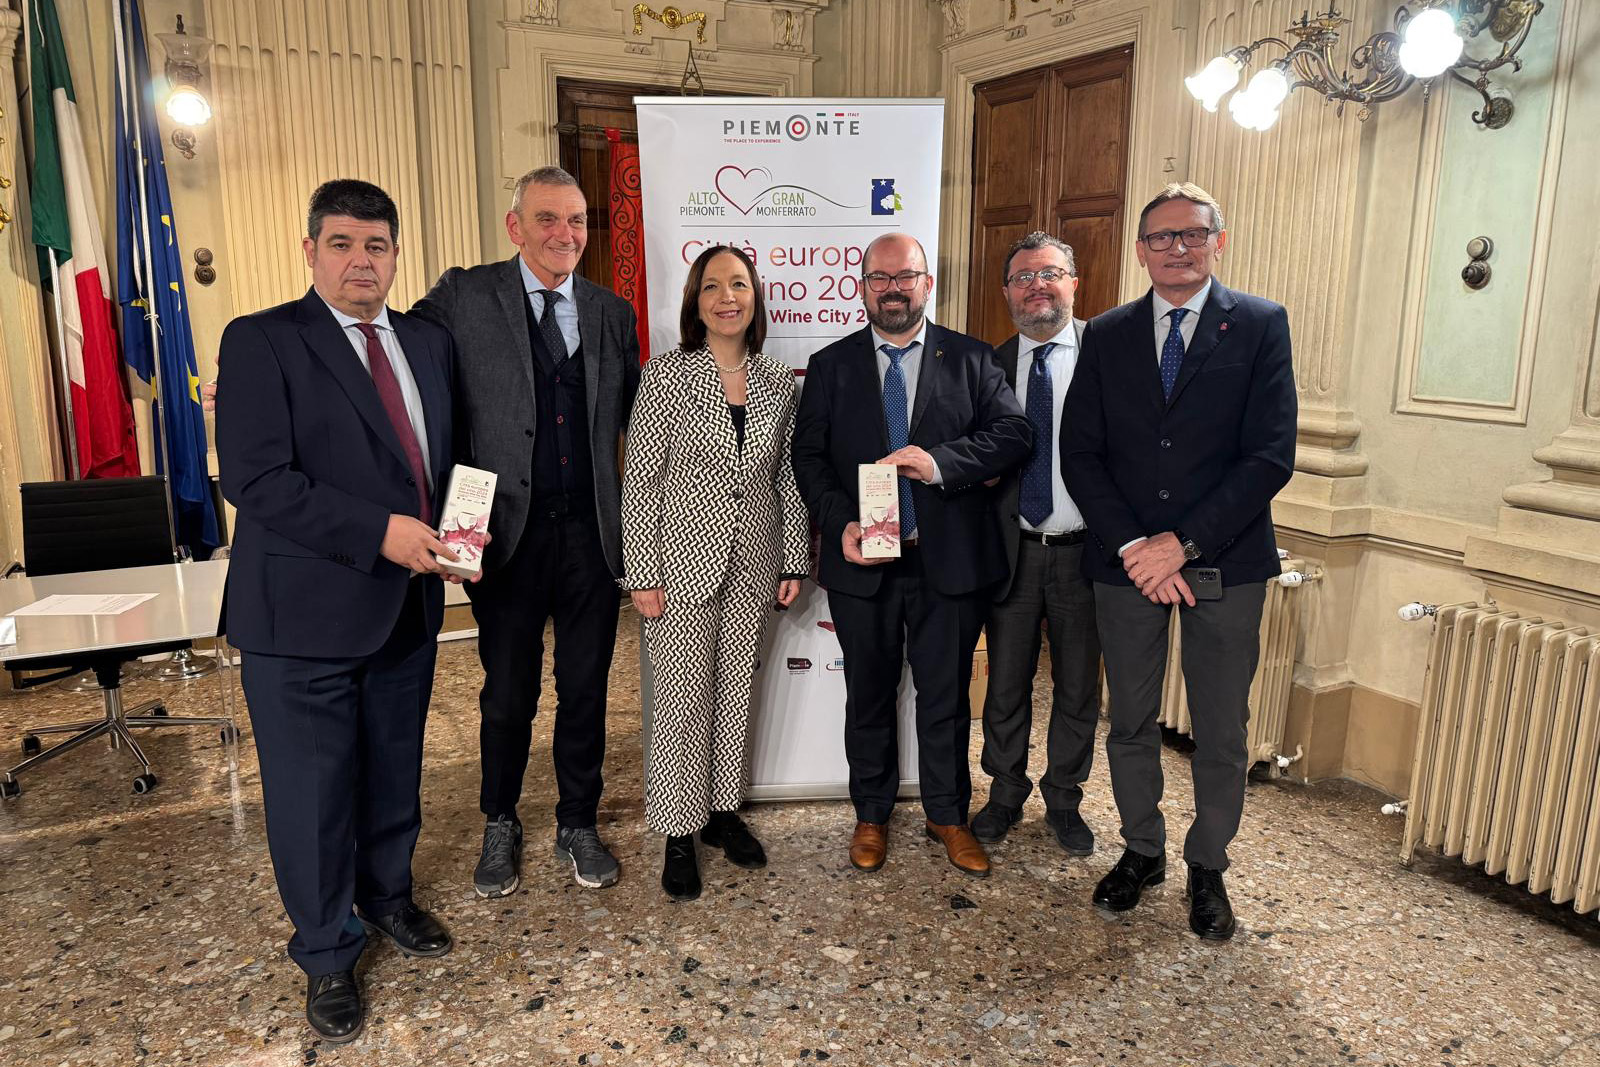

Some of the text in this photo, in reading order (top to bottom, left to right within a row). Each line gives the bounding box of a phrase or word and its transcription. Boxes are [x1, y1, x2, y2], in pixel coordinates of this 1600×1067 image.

[723, 114, 860, 141] PIEMONTE
[688, 192, 719, 205] ALTO
[772, 192, 805, 206] GRAN
[680, 206, 725, 216] PIEMONTE
[756, 206, 816, 217] MONFERRATO
[769, 245, 862, 271] europ
[761, 275, 861, 301] ino 20
[769, 309, 813, 323] Wine
[817, 309, 851, 325] City
